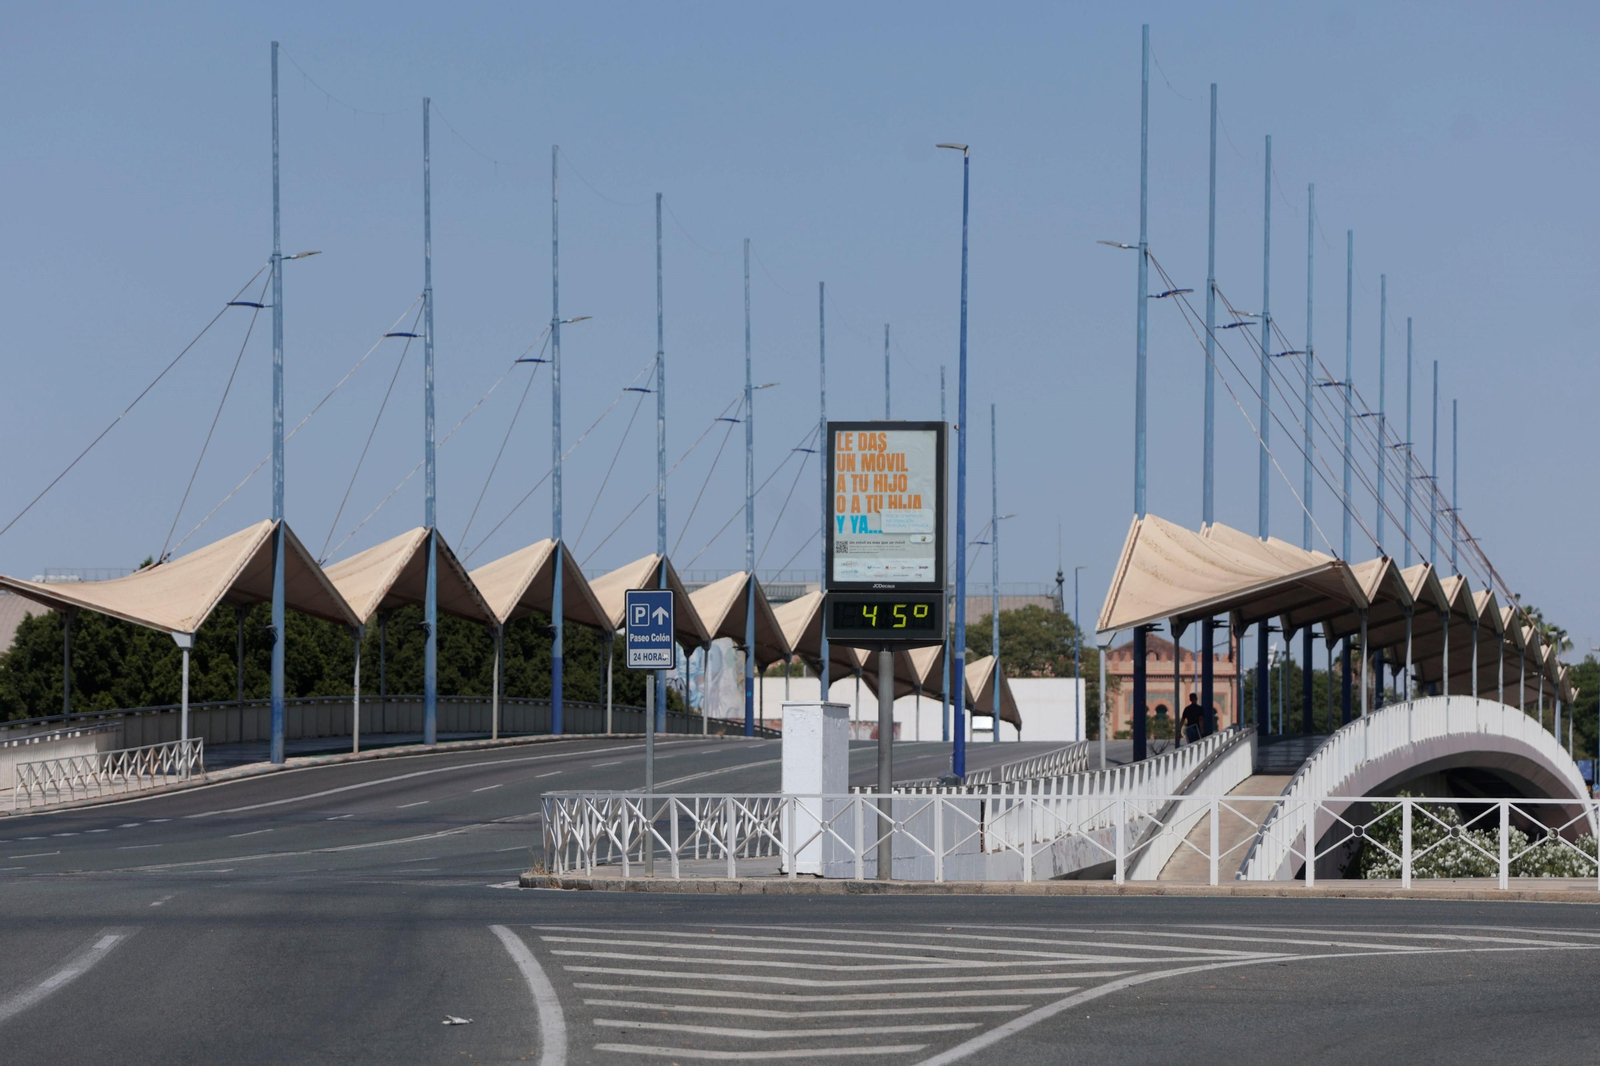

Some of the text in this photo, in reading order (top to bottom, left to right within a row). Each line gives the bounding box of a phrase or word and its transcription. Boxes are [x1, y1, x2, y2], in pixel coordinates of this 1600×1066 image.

[836, 432, 887, 452] LE DAS
[836, 451, 908, 472] UN MÓVIL
[836, 474, 908, 493] A TU HIJO
[836, 494, 922, 513] O A TU HIJA
[836, 515, 845, 534] Y
[635, 607, 646, 624] P
[630, 633, 670, 642] Paseo Colón
[634, 653, 642, 662] 24
